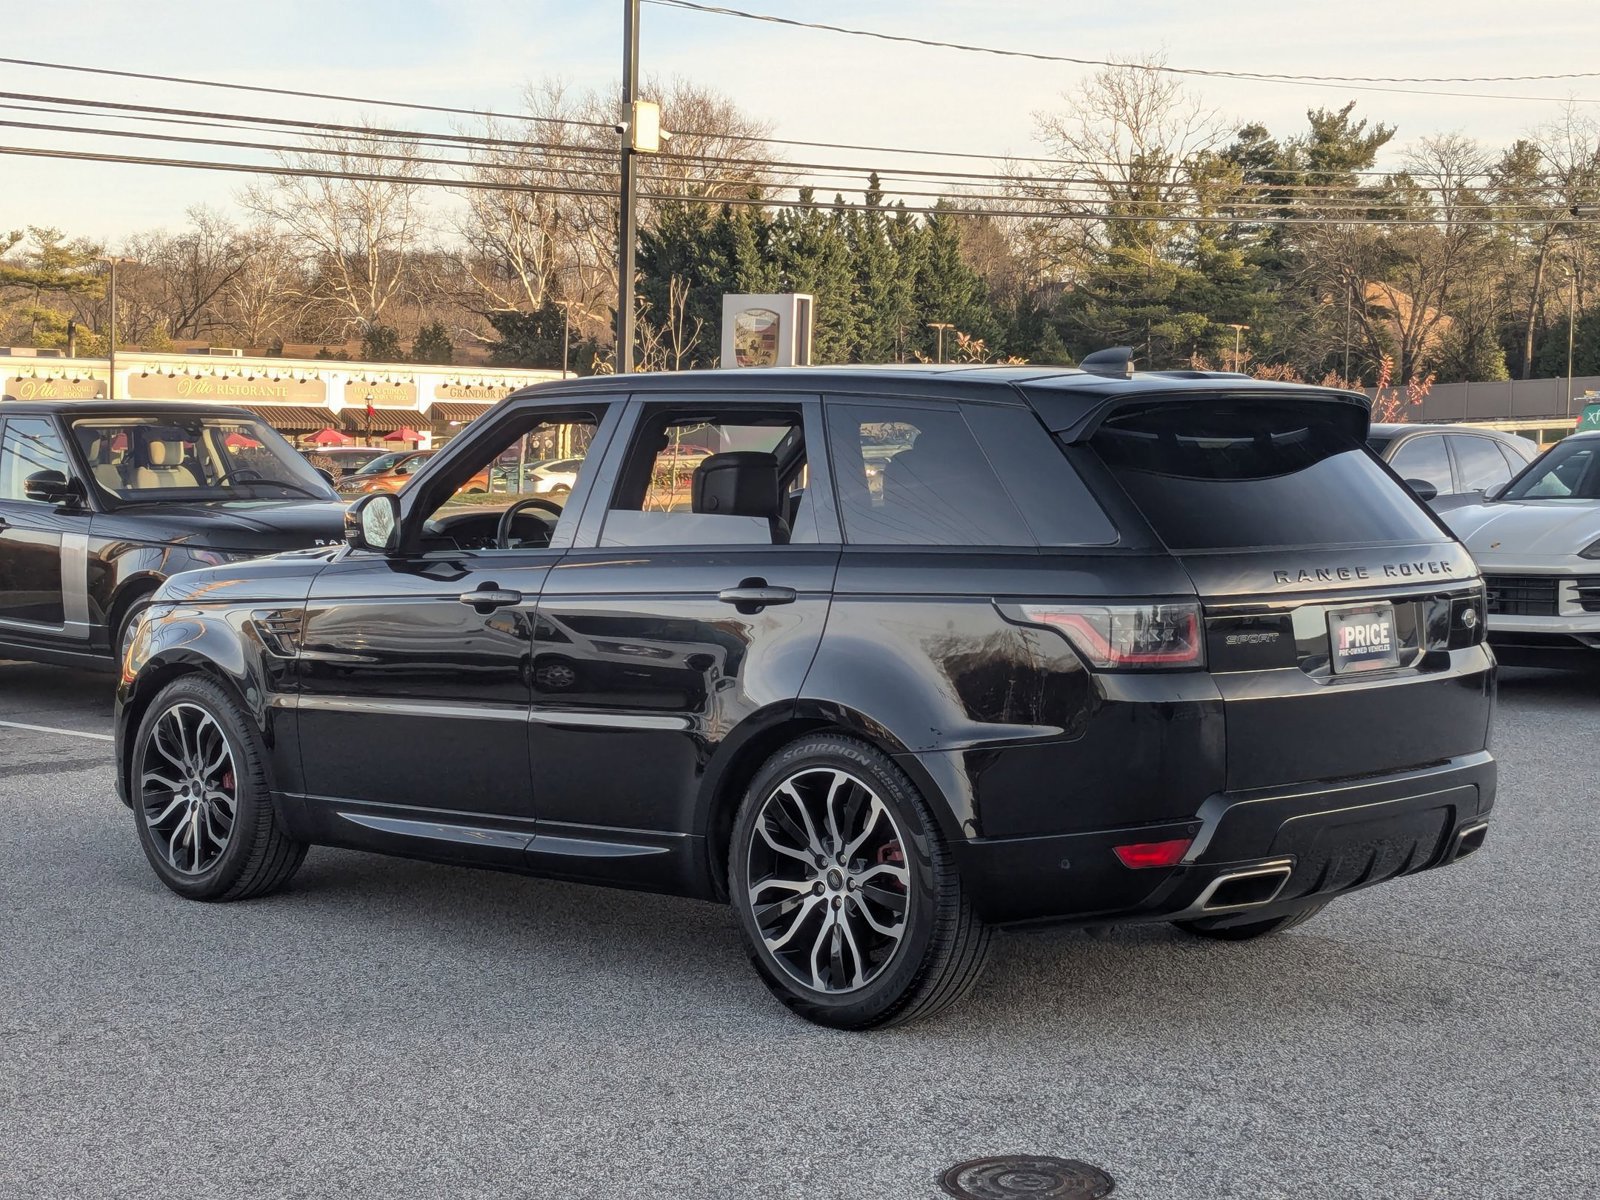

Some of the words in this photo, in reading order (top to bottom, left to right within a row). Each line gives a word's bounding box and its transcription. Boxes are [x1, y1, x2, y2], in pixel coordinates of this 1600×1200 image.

[216, 385, 288, 397] RISTORANTE
[1273, 566, 1369, 584] RANGE
[1383, 560, 1453, 577] ROVER
[1226, 632, 1279, 645] SPORT
[1338, 646, 1368, 657] PRE-OWNED
[1368, 643, 1391, 653] VEHICLES
[783, 743, 871, 766] SCORPION
